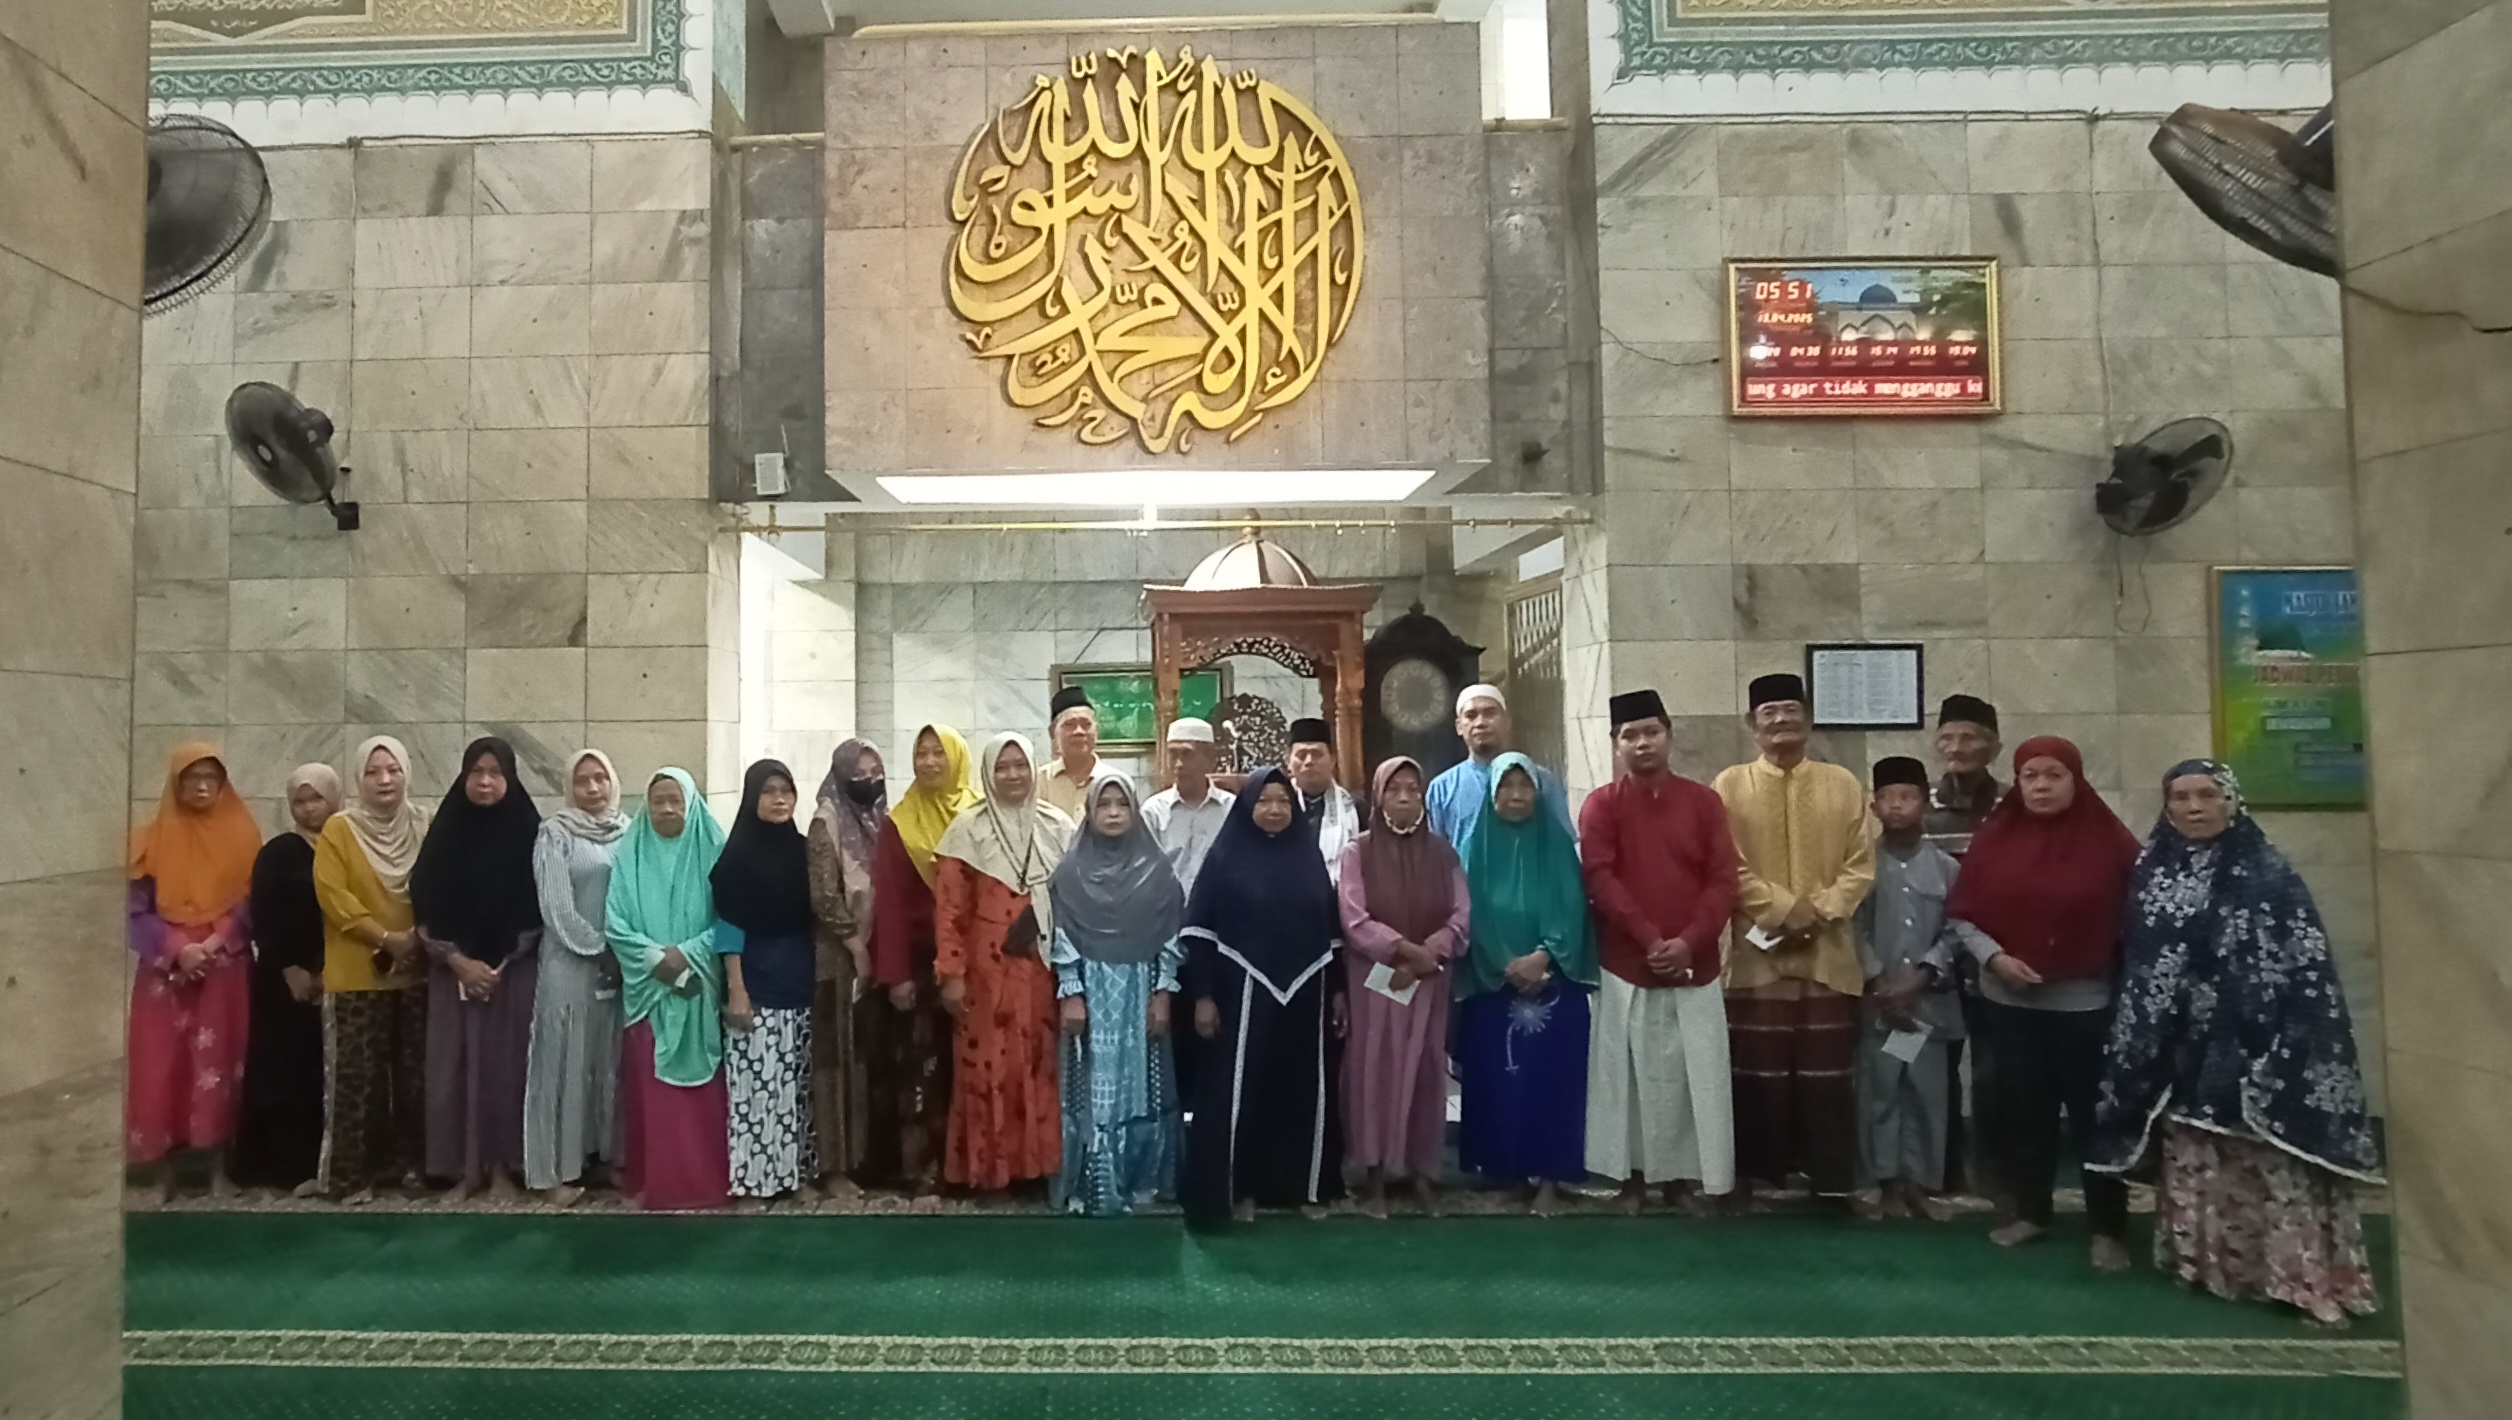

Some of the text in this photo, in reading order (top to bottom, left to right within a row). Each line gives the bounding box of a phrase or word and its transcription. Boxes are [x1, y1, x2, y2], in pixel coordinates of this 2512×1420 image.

[1781, 383, 1818, 398] agar
[1823, 380, 1868, 395] tidak
[1874, 382, 1961, 398] mengganggu
